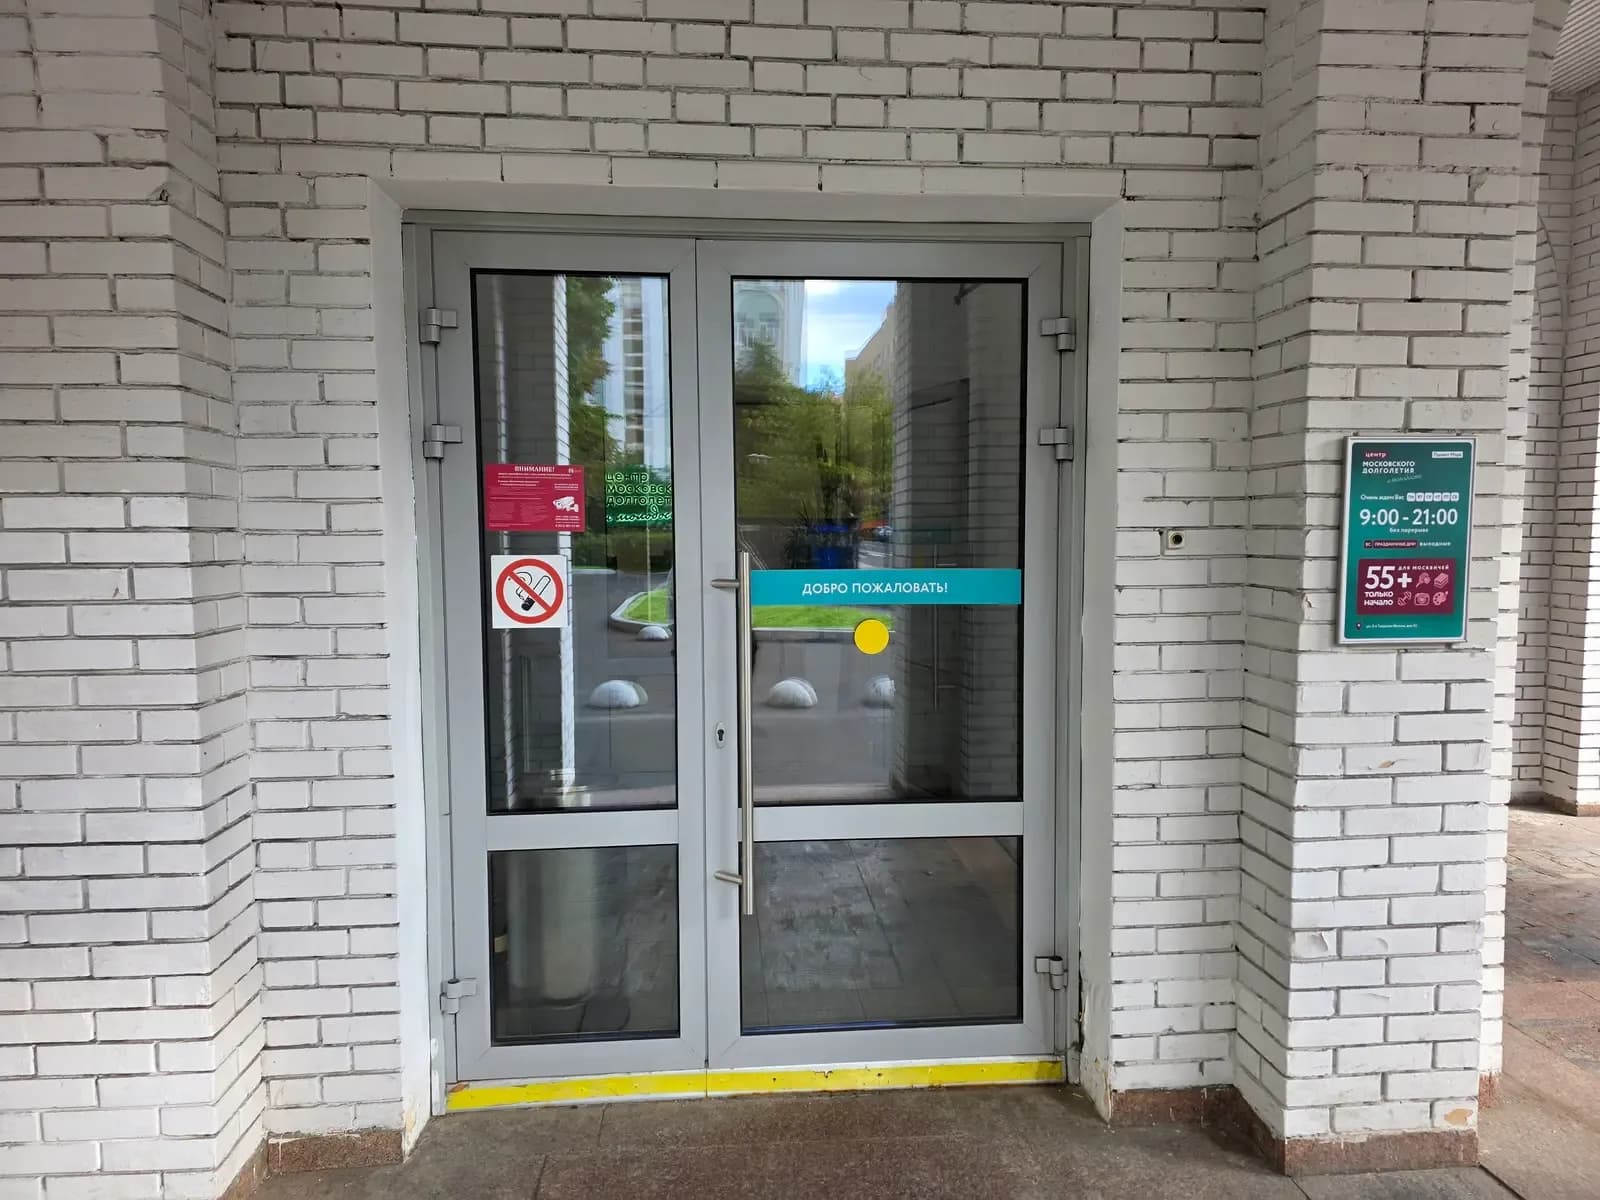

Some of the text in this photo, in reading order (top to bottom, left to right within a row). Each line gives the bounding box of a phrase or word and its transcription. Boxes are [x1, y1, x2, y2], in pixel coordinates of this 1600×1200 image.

[514, 465, 555, 473] ВНИМАНИЕ!
[1362, 460, 1415, 468] МОСКОВСКОГО
[1360, 508, 1399, 526] 9:00
[1412, 508, 1458, 525] 21:00
[802, 582, 948, 596] ДОБРО ПОЖАЛОВАТЬ!
